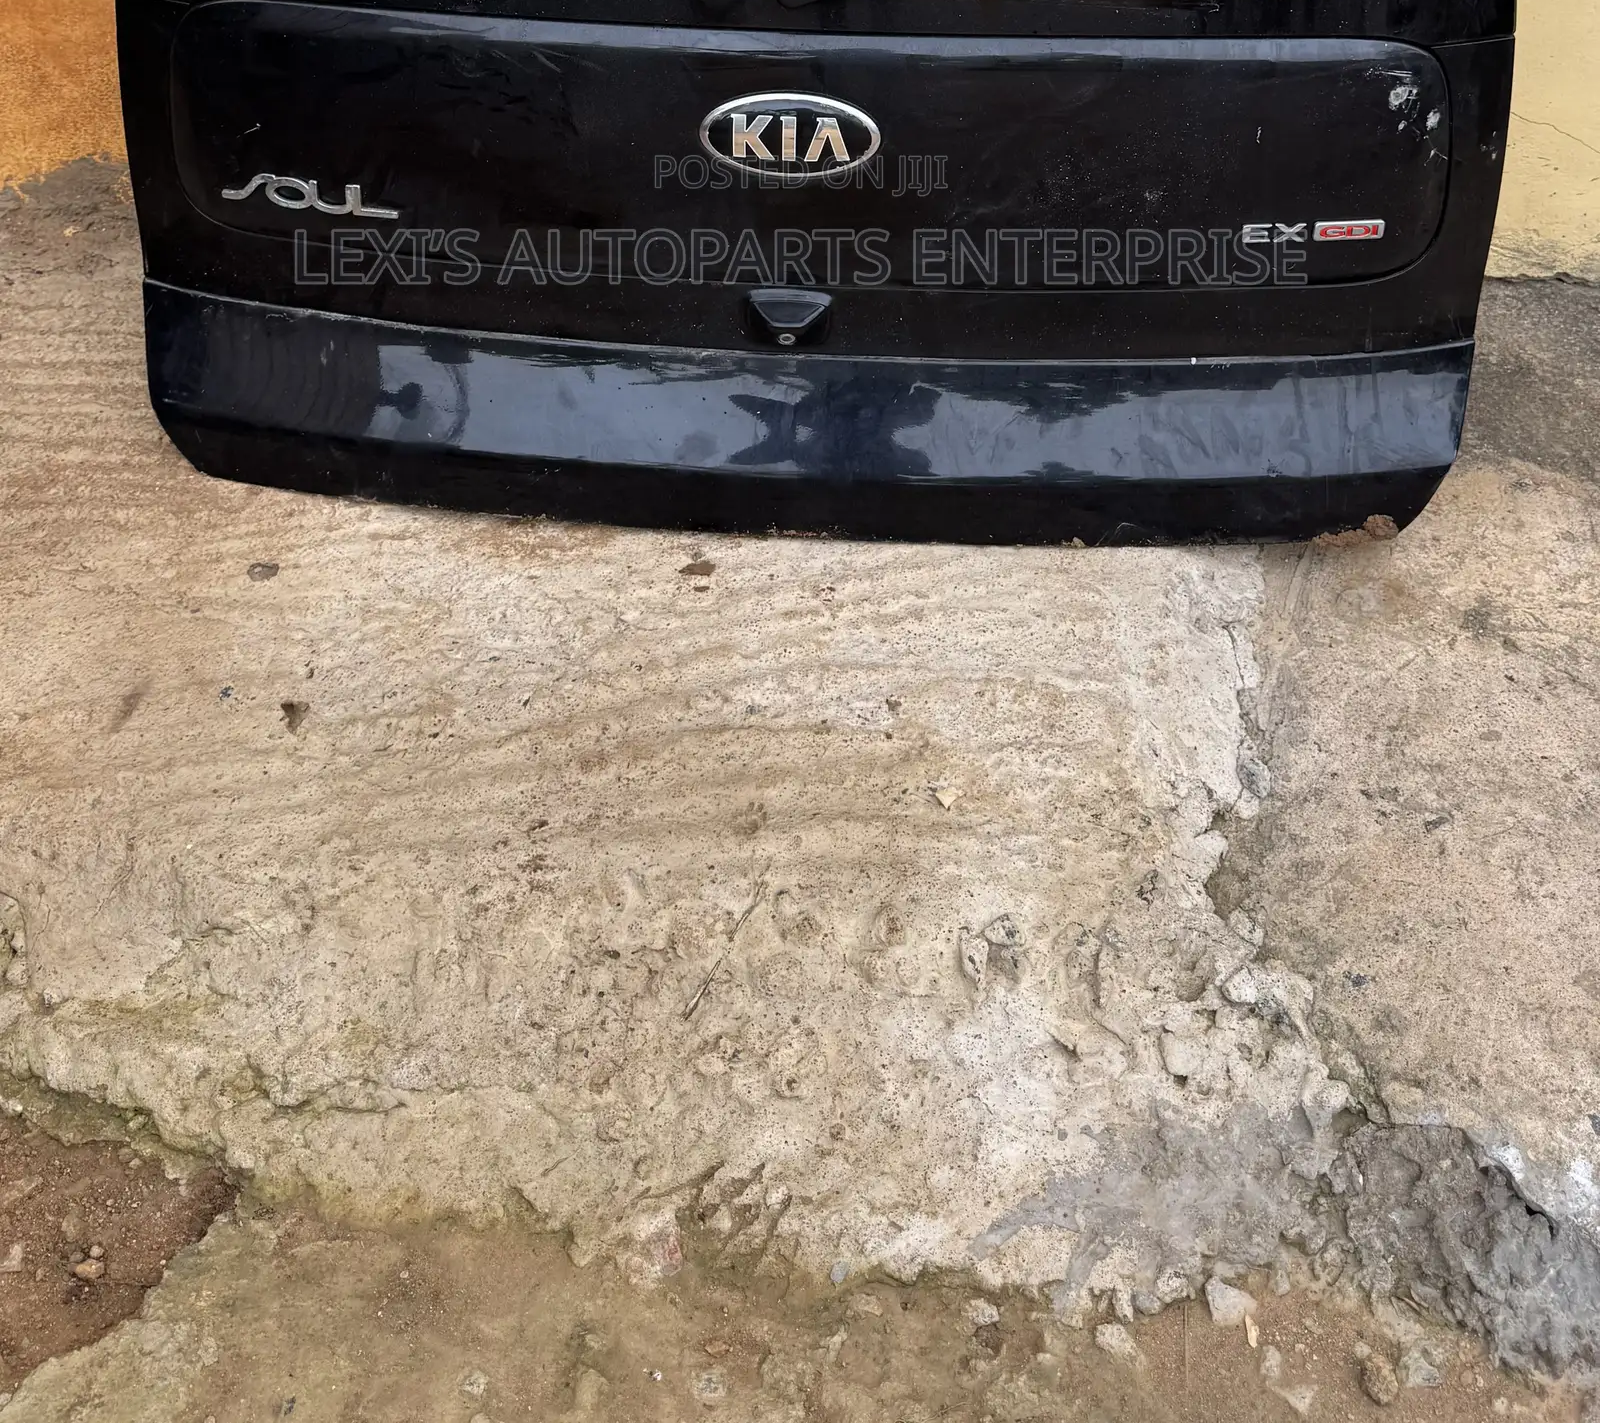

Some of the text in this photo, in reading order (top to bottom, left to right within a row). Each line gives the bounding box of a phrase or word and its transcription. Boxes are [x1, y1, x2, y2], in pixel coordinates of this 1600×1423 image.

[731, 113, 850, 162] KIA
[221, 173, 398, 219] SOUL
[1242, 223, 1380, 243] EX GDI
